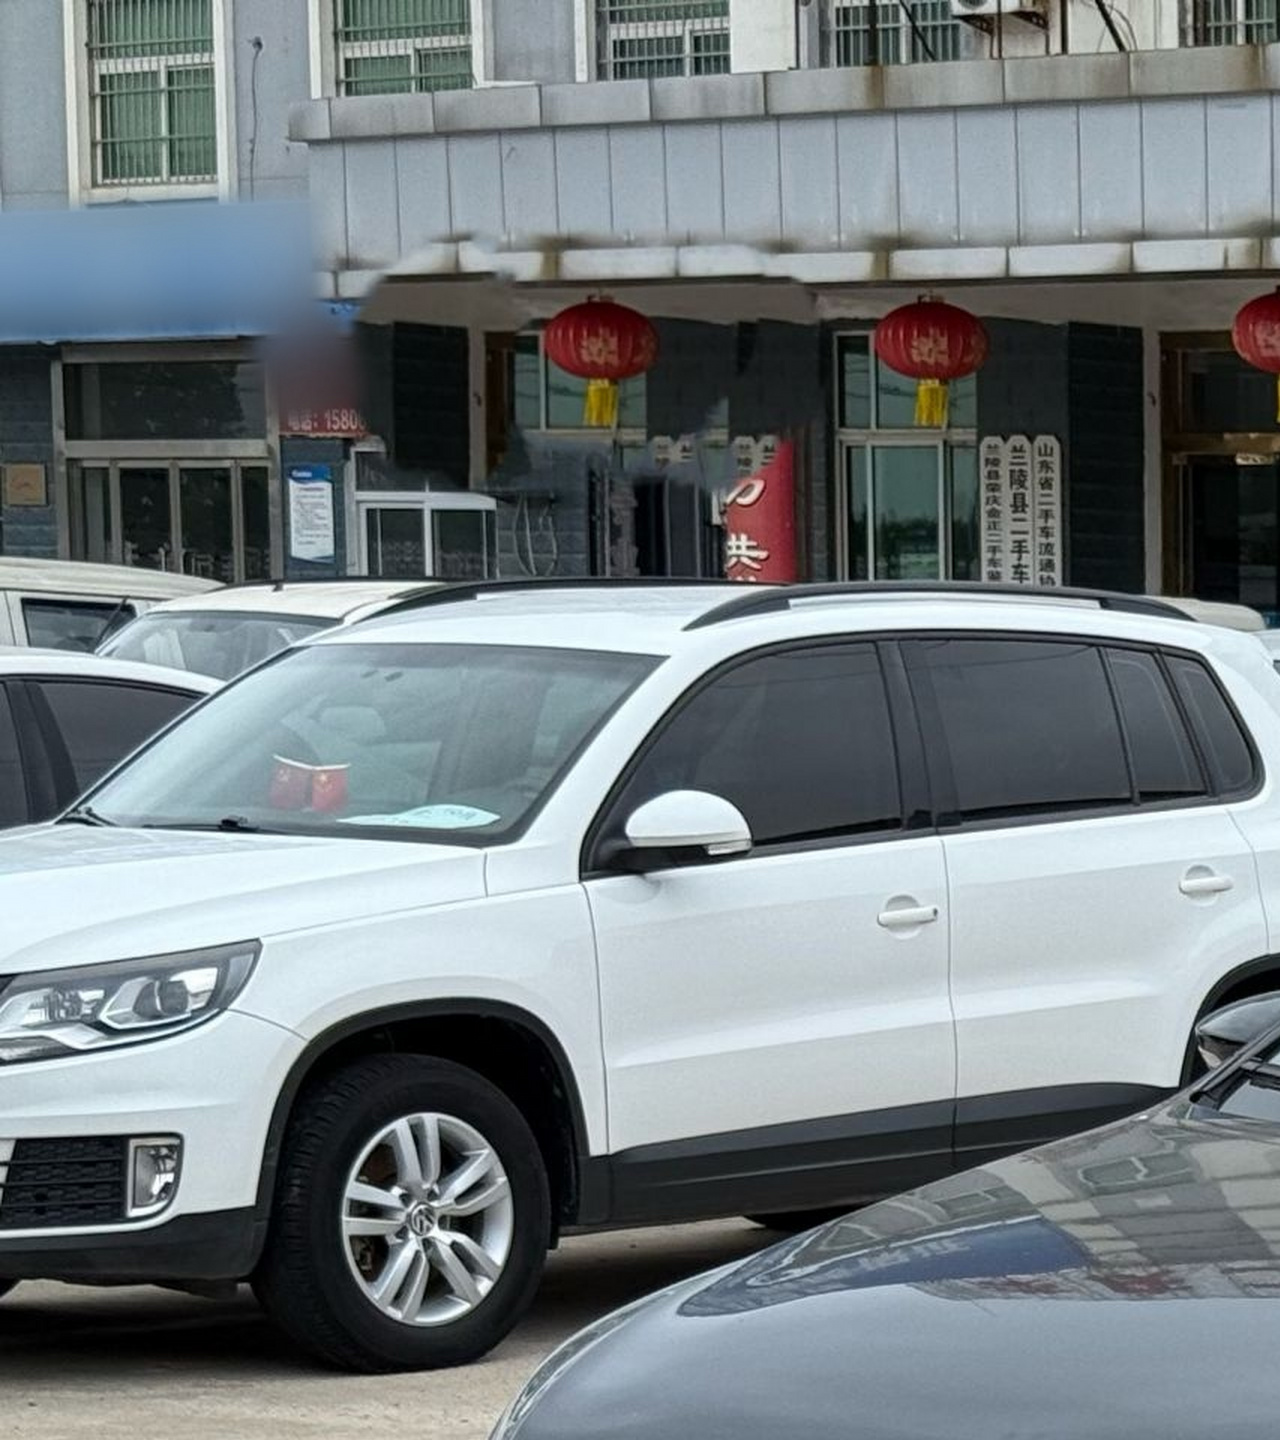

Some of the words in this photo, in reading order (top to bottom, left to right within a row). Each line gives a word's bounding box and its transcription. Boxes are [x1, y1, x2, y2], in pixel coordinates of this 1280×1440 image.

[1008, 444, 1030, 584] 兰陵县二手车
